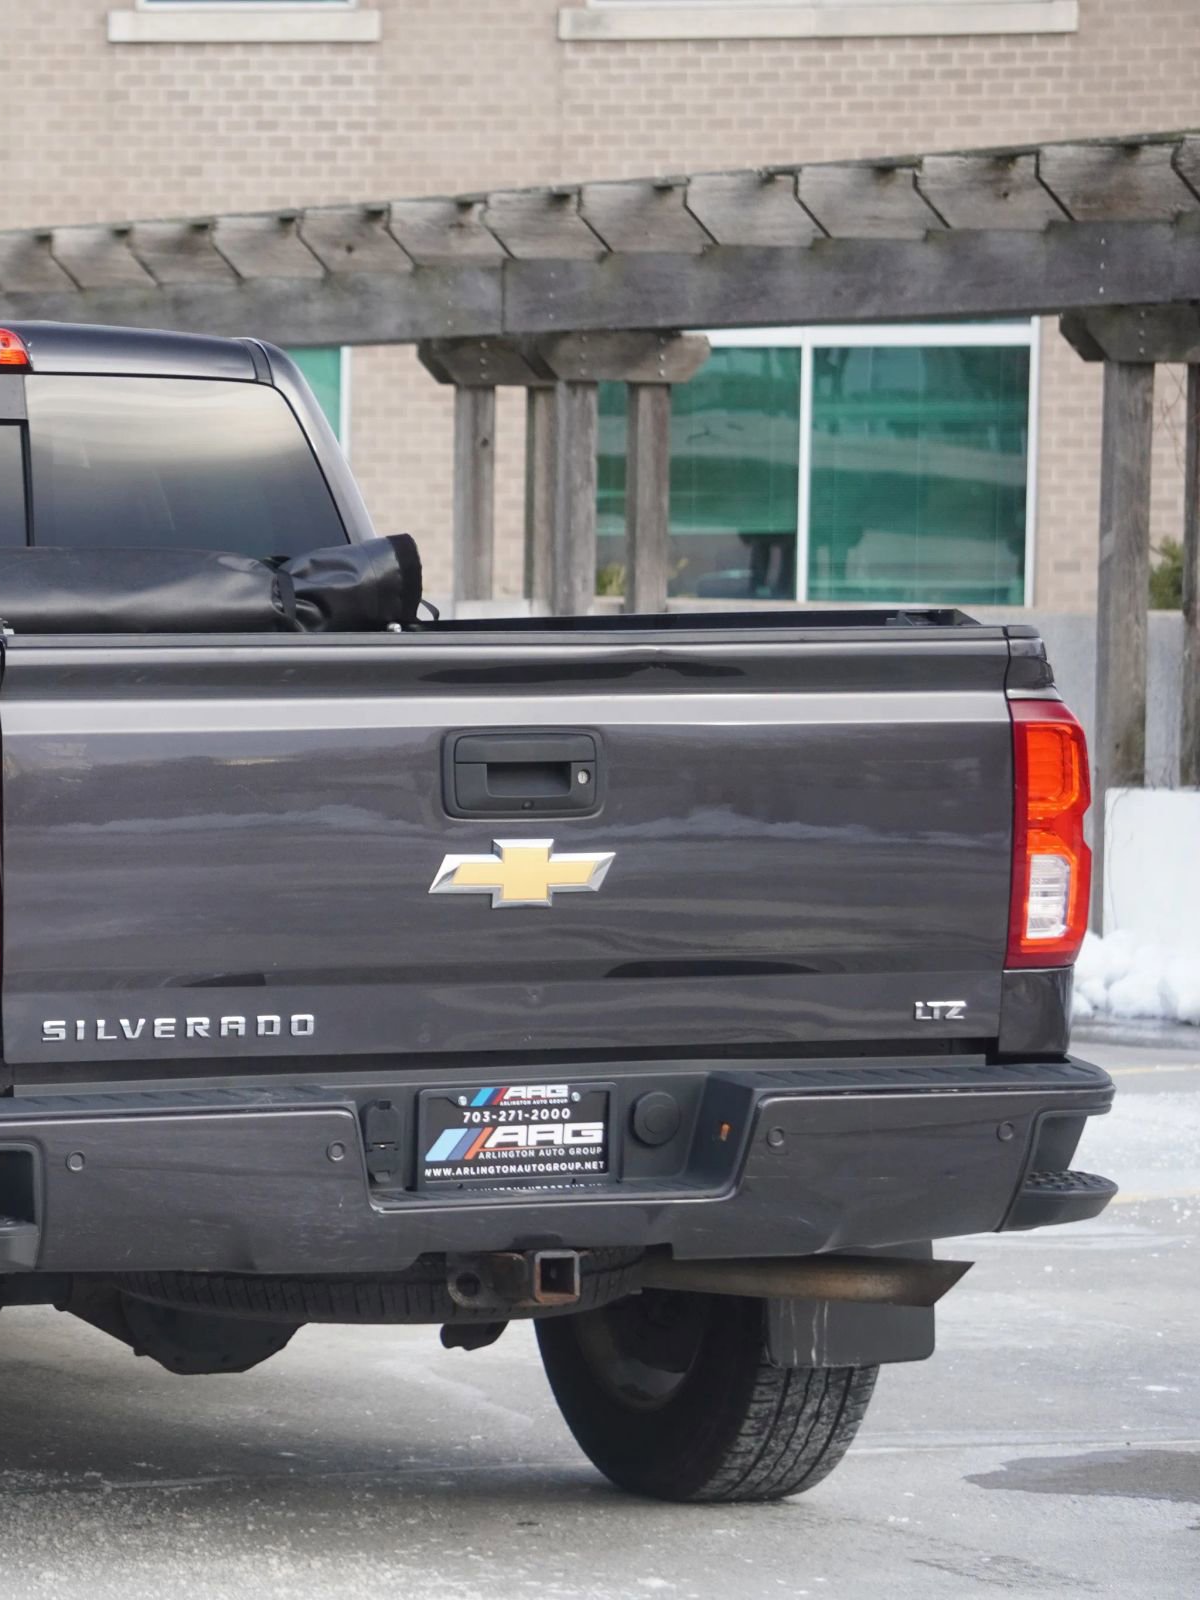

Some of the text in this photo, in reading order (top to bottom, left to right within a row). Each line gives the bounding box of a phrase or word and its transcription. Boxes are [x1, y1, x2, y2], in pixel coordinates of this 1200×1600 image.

[914, 1000, 966, 1019] LTZ
[41, 1014, 314, 1041] SILVERADO
[503, 1085, 568, 1099] AAG
[463, 1108, 571, 1124] 703-271-2000
[484, 1122, 604, 1148] AAG
[478, 1147, 603, 1160] ARLINGTON AUTO GROUP
[425, 1161, 605, 1177] WWW.ARLINGTONAUTOGROUP.NET
